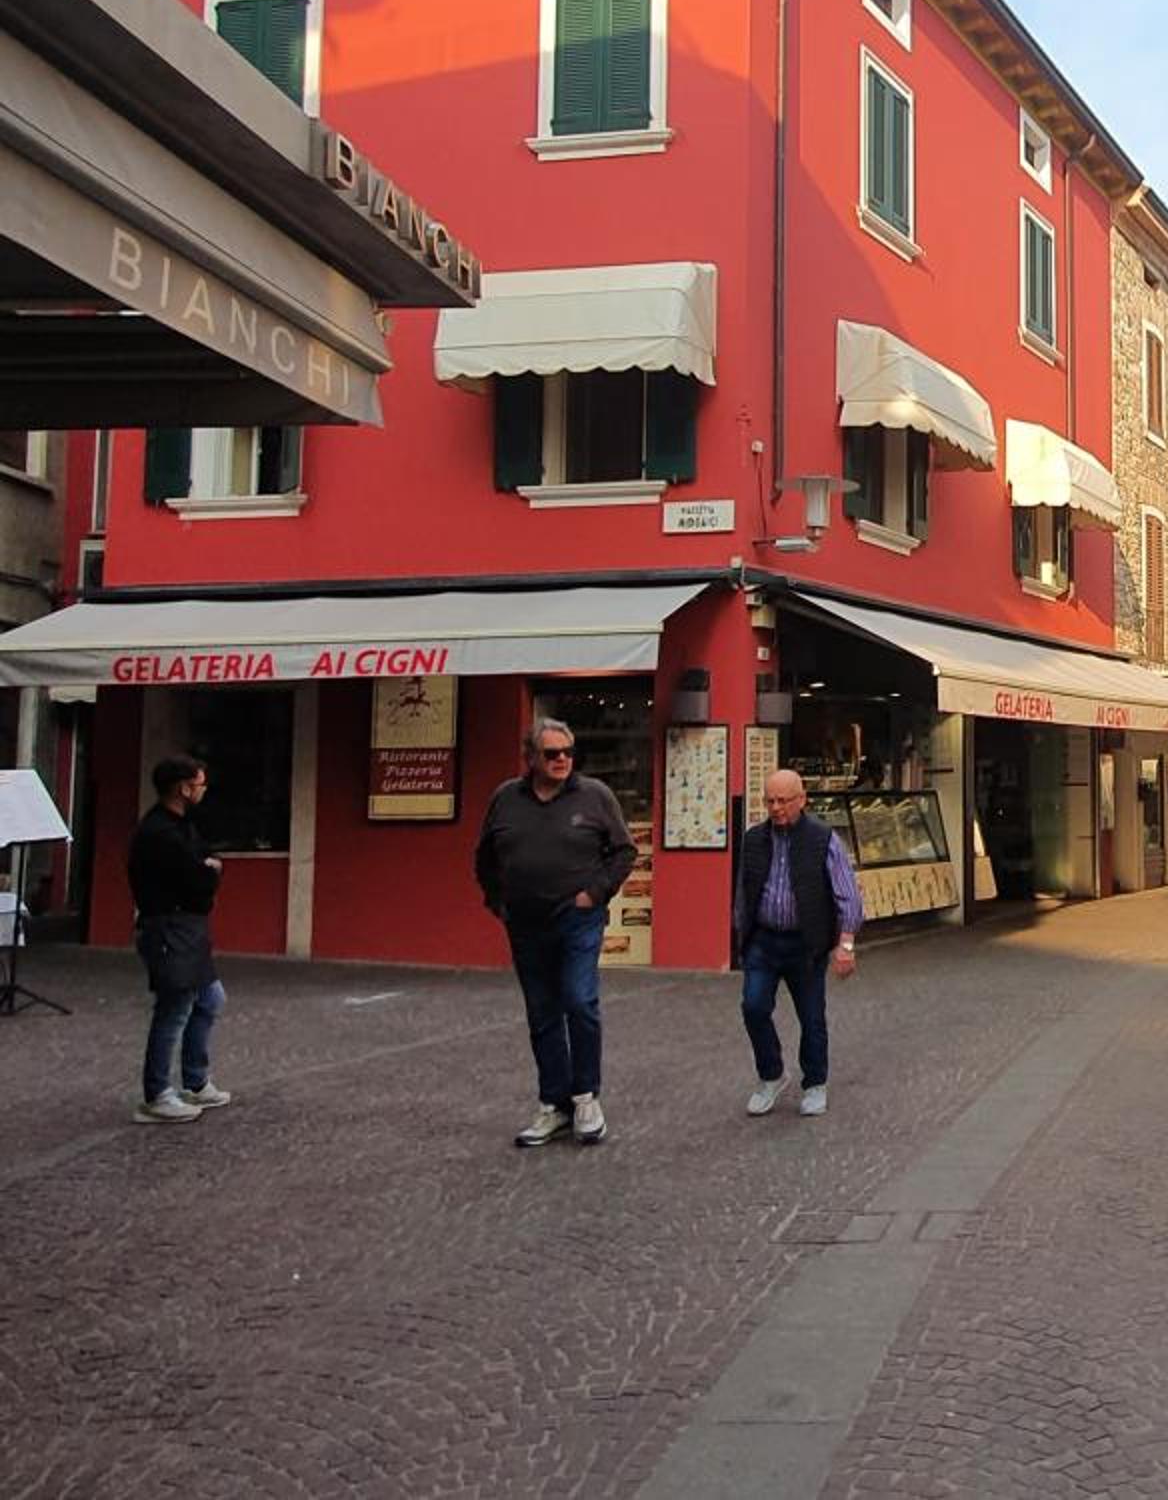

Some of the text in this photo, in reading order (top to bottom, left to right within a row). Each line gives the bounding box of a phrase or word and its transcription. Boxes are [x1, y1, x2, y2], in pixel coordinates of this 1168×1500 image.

[110, 227, 349, 405] BIANCHI
[113, 648, 449, 682] GELATERIA AI CIGNI
[995, 692, 1053, 719] GELATERIA
